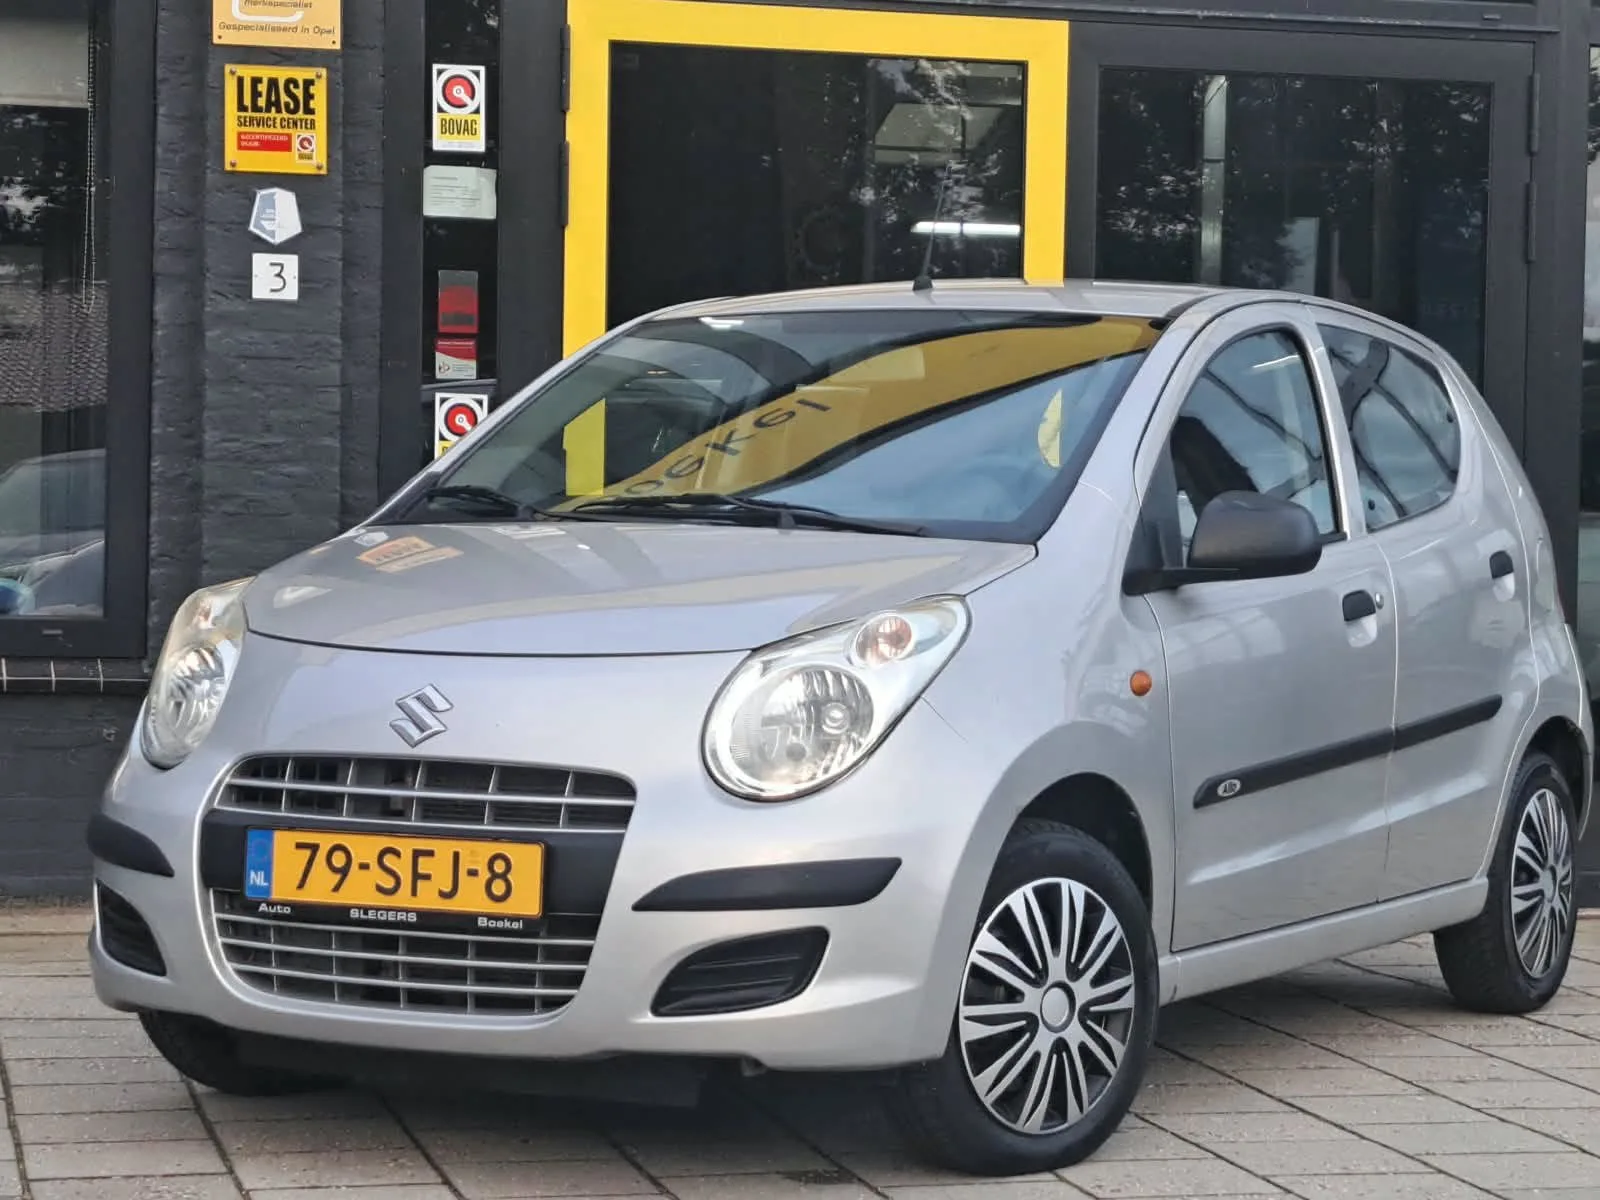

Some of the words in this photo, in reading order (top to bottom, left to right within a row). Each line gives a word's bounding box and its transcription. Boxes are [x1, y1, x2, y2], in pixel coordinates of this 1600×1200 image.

[218, 21, 298, 33] Gespecialiseerd
[301, 25, 310, 33] in
[313, 25, 335, 36] Opel
[236, 75, 316, 115] LEASE
[236, 115, 278, 129] SERVICE
[279, 117, 316, 130] CENTER
[440, 117, 478, 136] BOVAG
[269, 262, 287, 293] 3
[249, 869, 269, 887] NL
[294, 841, 513, 903] 79-SFJ-8
[258, 903, 292, 914] Auto
[349, 908, 417, 922] SLEGERS
[477, 917, 523, 930] Boekel
